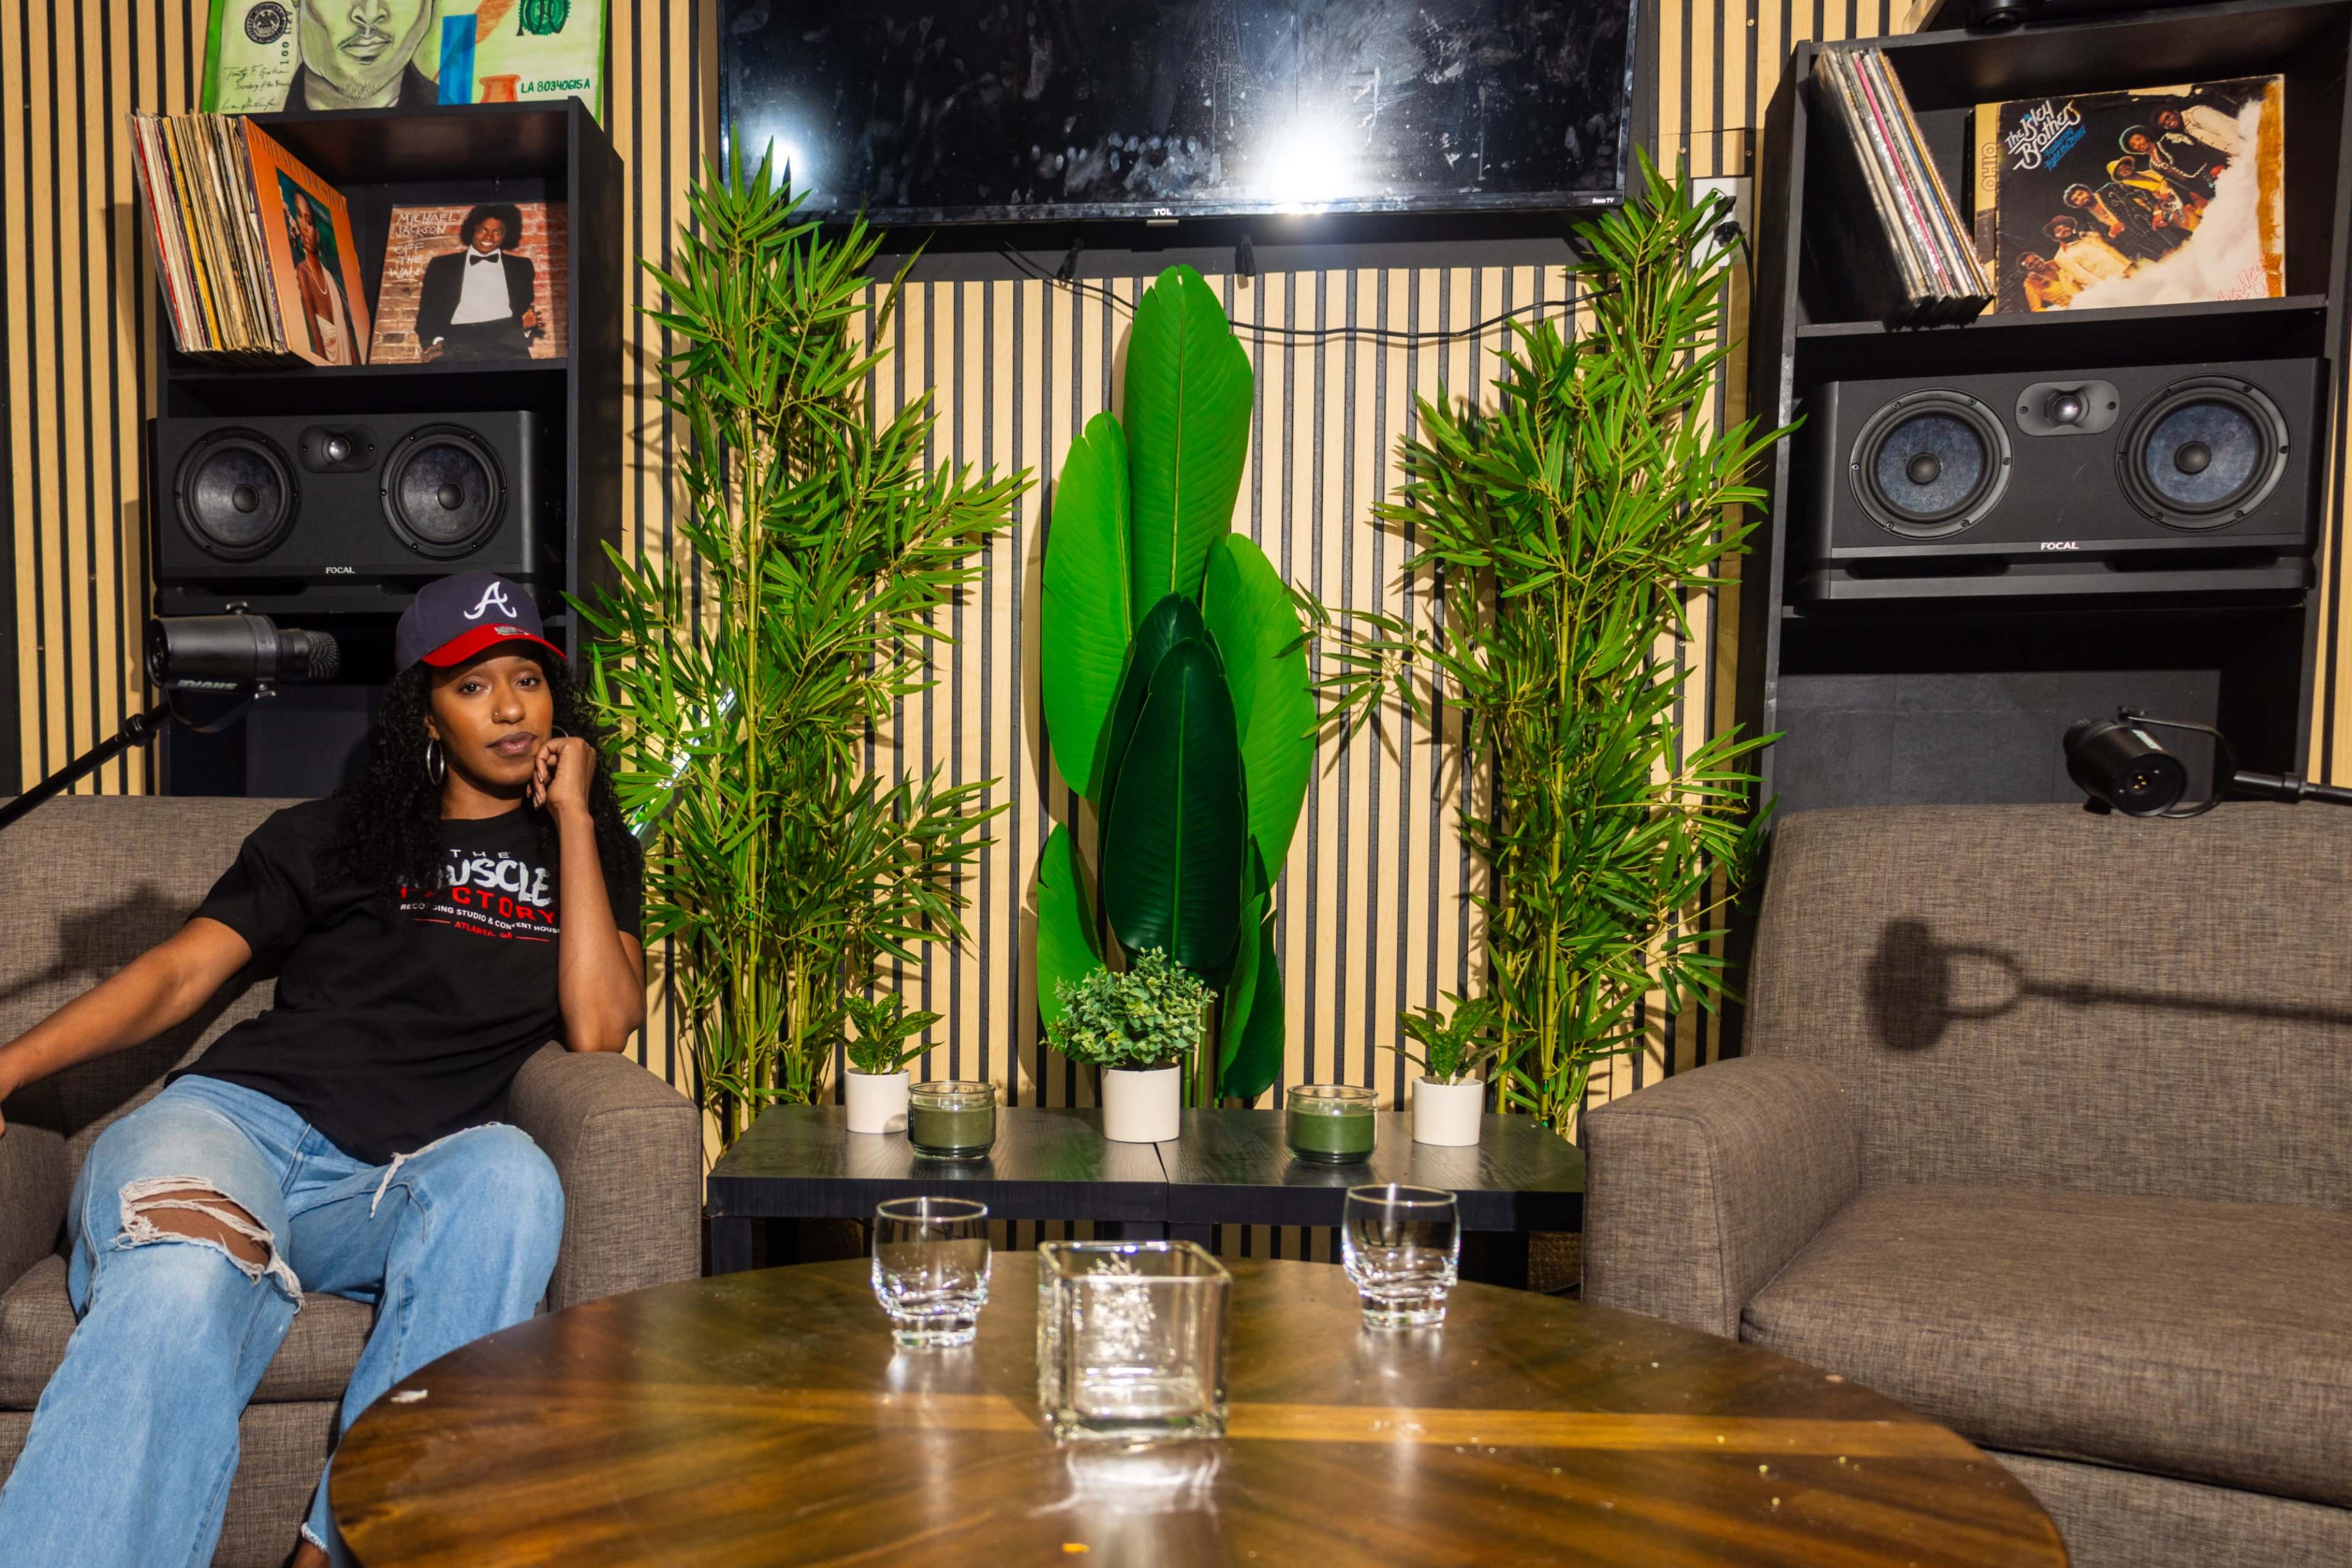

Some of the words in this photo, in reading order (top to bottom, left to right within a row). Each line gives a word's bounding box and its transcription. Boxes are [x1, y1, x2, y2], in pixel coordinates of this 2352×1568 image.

[521, 81, 533, 93] LA
[1981, 141, 1997, 192] OHIO
[396, 211, 457, 226] MICHAEL
[396, 224, 448, 238] JACKSON
[395, 243, 424, 256] OFF
[397, 255, 424, 265] THE
[389, 266, 421, 279] WALL
[2040, 541, 2079, 550] FOCAL
[464, 581, 518, 619] A
[451, 849, 511, 858] THE
[439, 859, 552, 907] USCLE
[456, 909, 486, 922] STUDIO
[533, 925, 560, 933] HOUS
